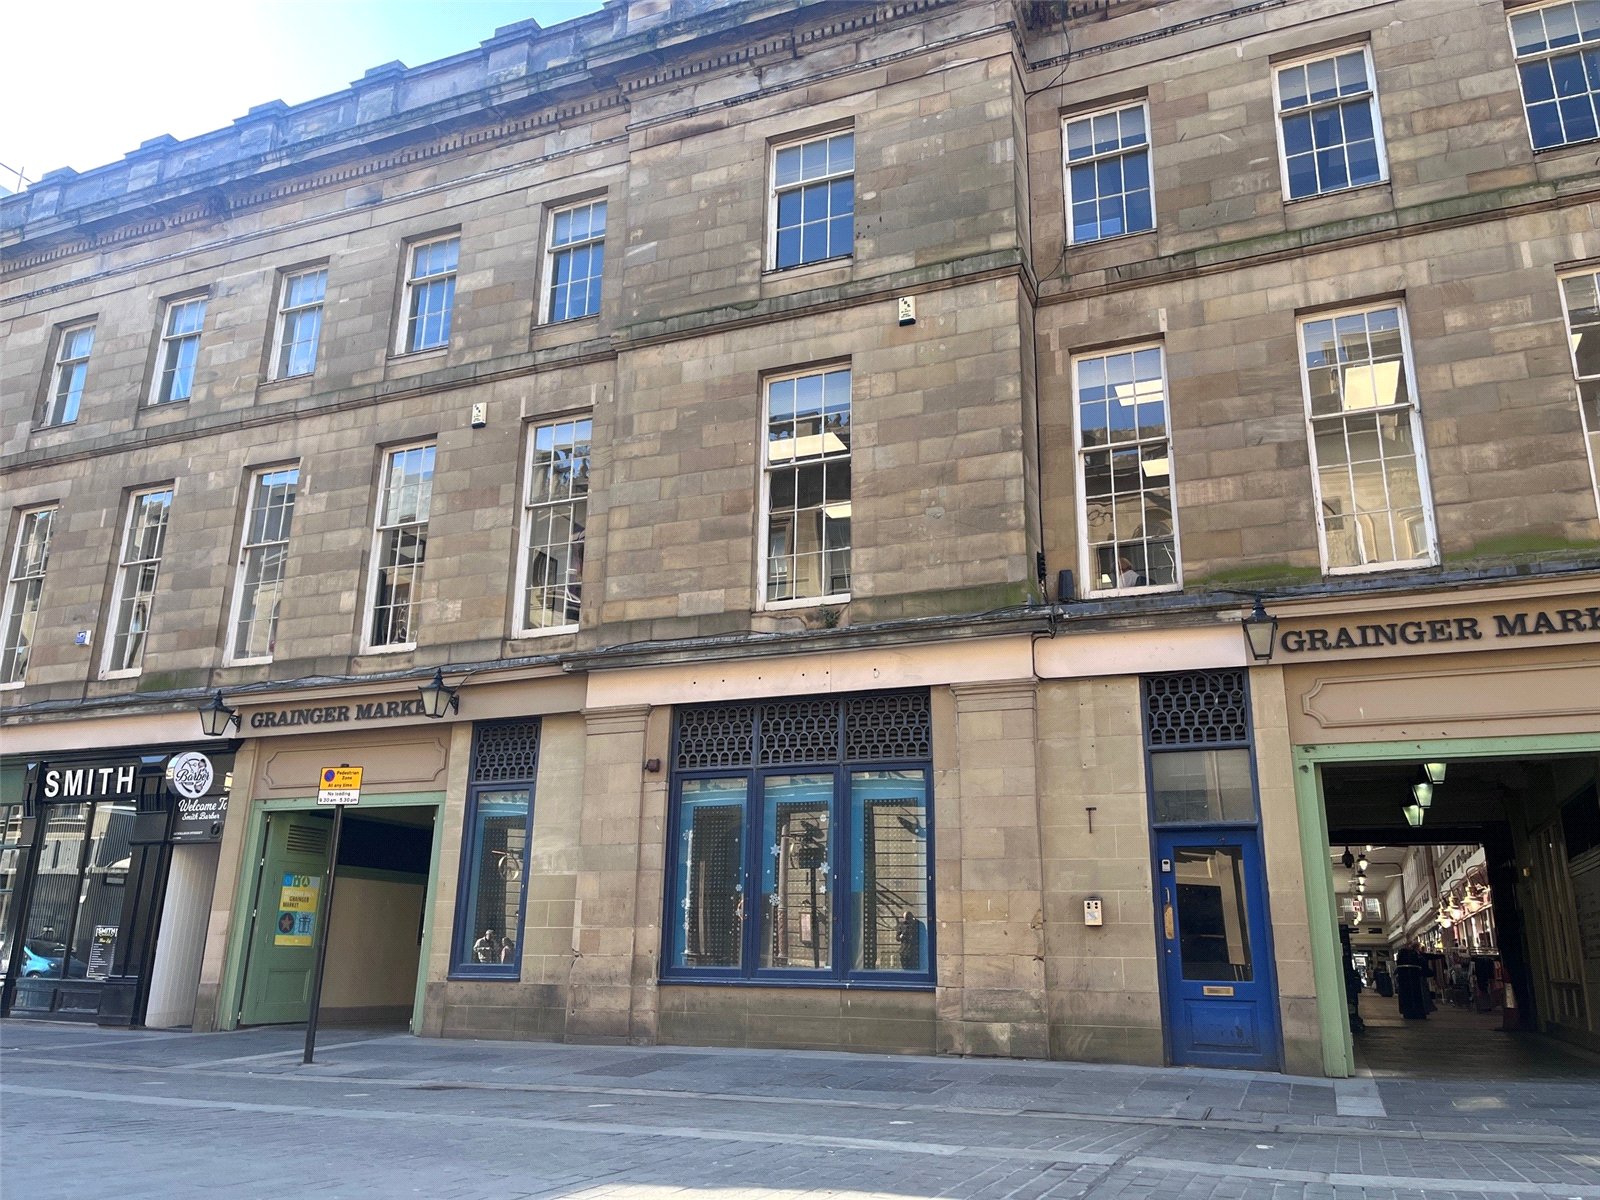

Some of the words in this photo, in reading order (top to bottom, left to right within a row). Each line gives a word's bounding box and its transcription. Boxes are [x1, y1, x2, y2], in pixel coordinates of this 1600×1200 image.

[1280, 617, 1482, 653] GRAINGER
[250, 706, 350, 729] GRAINGER
[354, 699, 425, 721] MARKE
[44, 766, 135, 798] SMITH
[176, 769, 210, 782] Barber
[178, 798, 217, 812] Welcome
[181, 812, 198, 821] Smith
[199, 811, 220, 820] Barber
